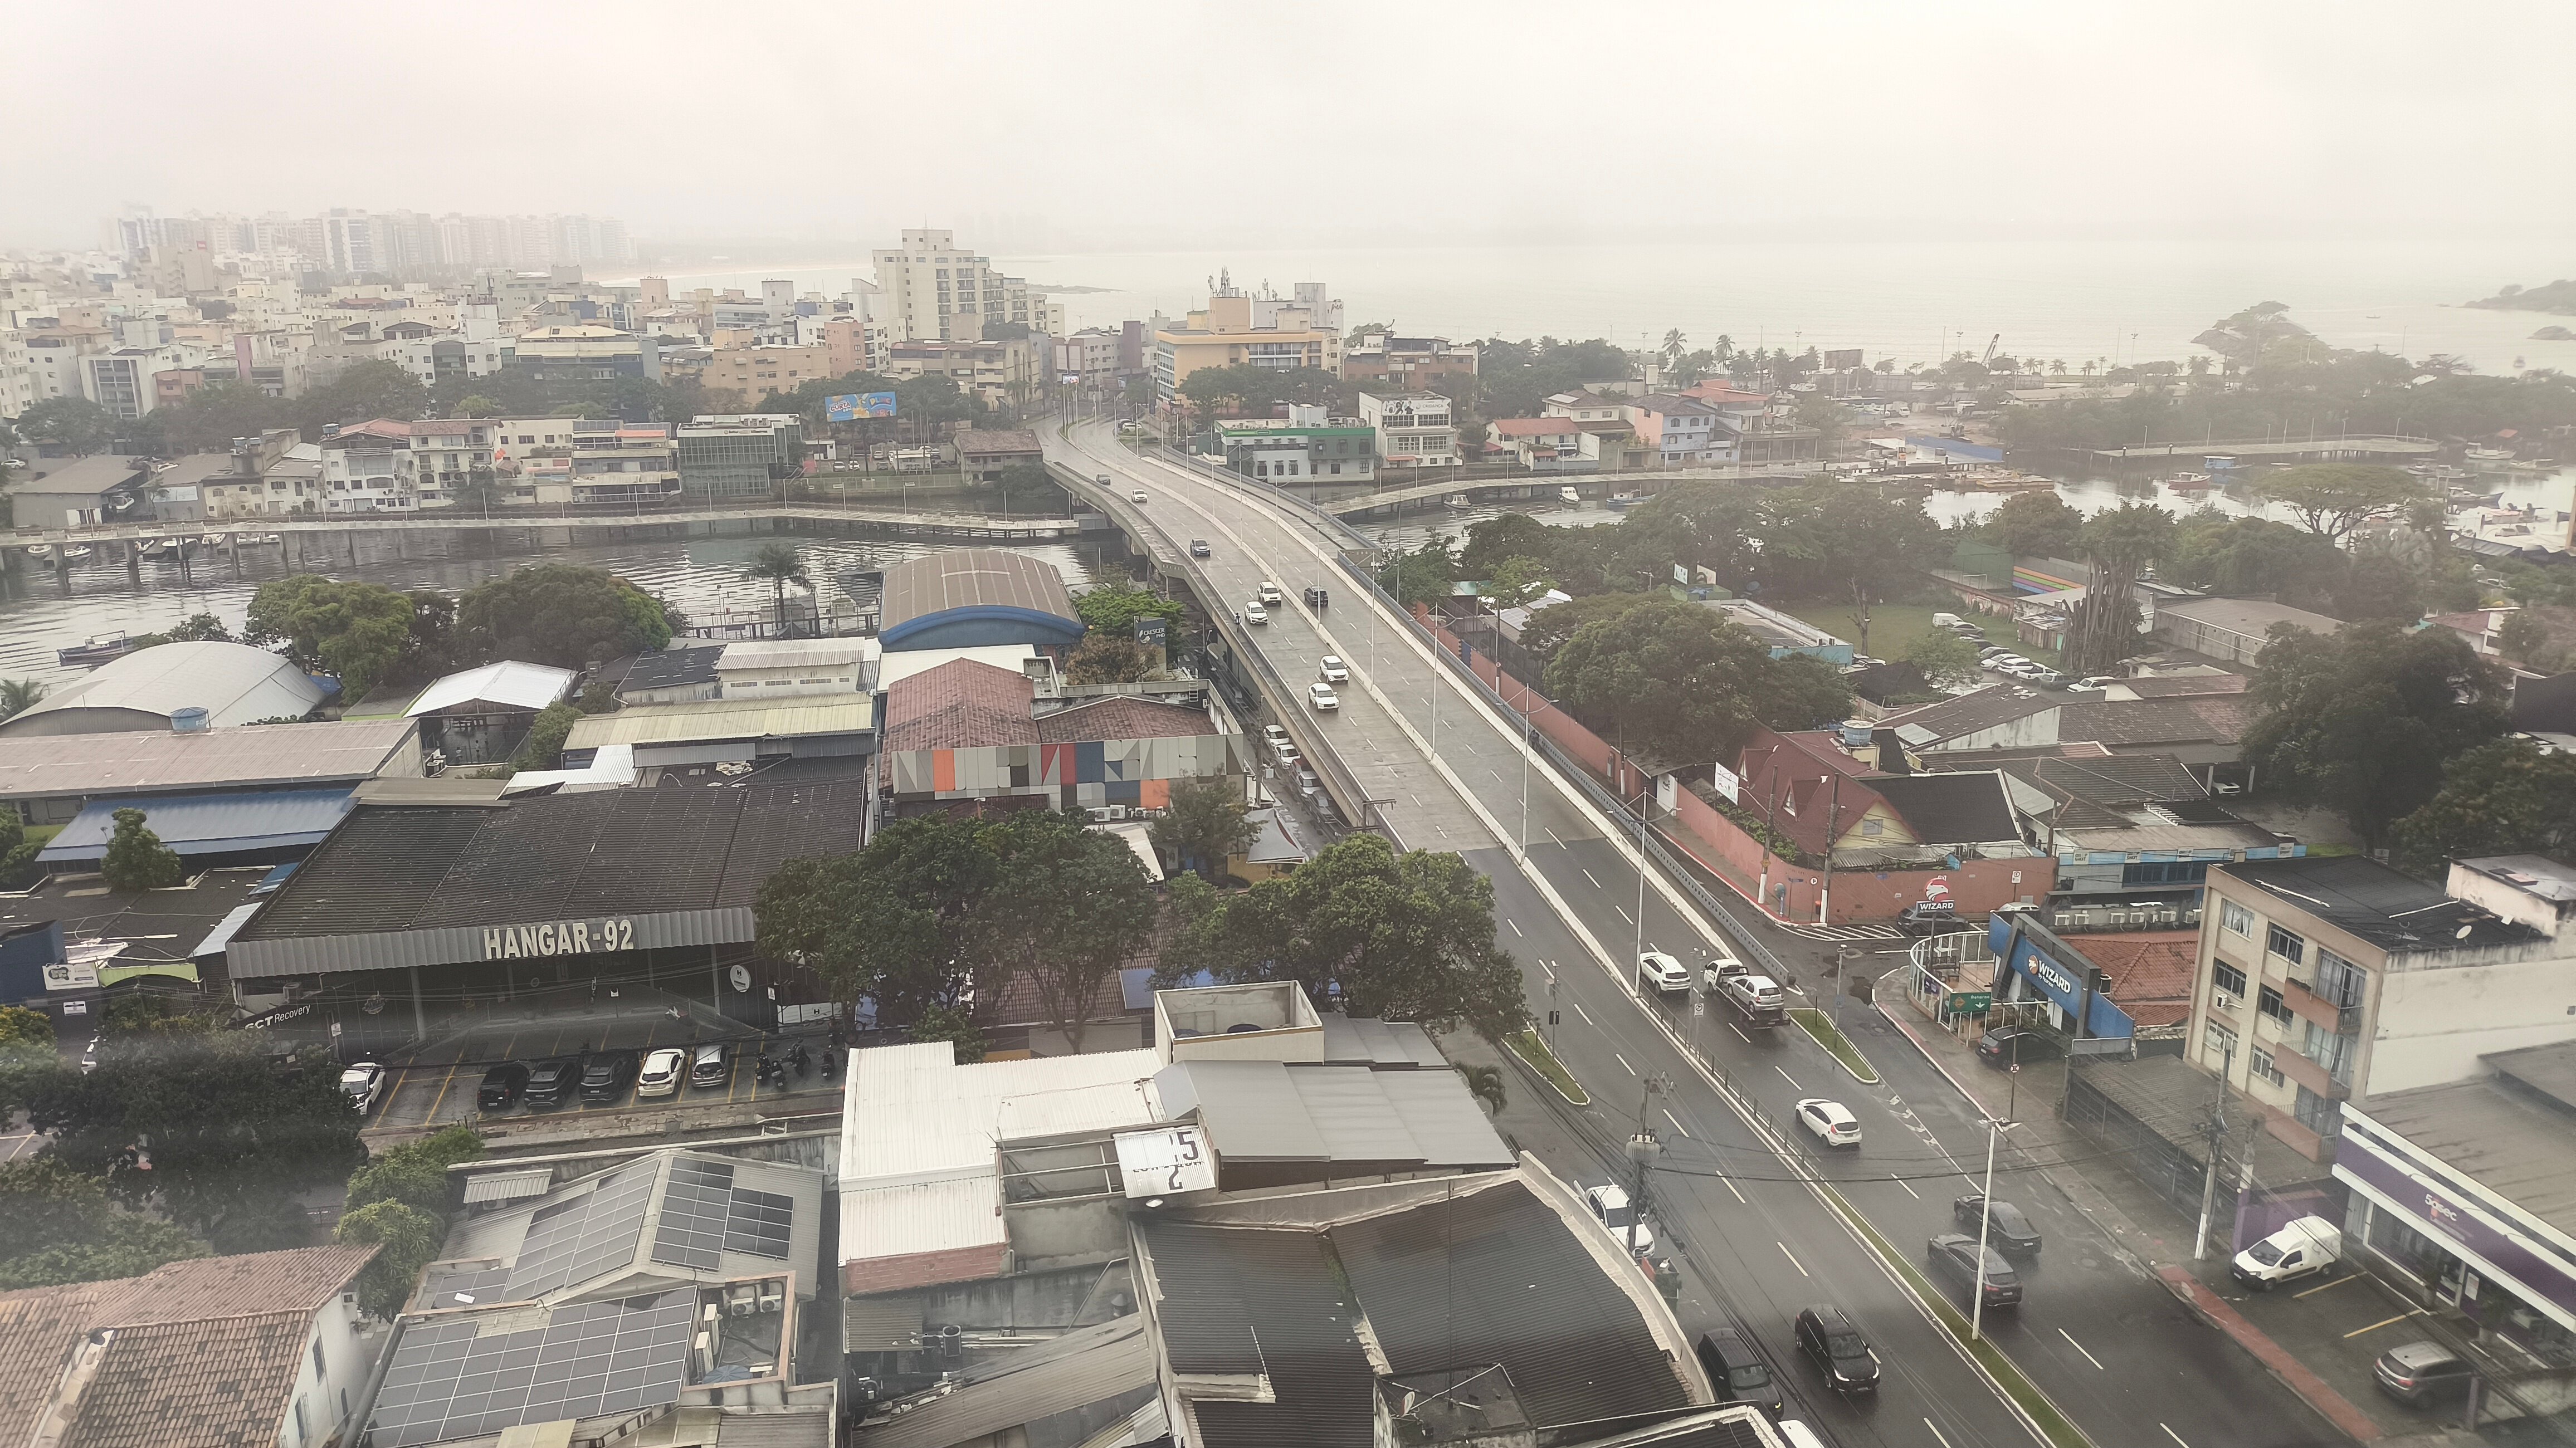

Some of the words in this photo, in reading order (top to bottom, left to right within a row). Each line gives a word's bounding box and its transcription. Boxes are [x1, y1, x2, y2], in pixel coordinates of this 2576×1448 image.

[1143, 628, 1165, 636] CRESCER
[1919, 902, 1954, 911] WIZARD
[2039, 960, 2071, 993] WIZARD
[274, 1004, 311, 1024] Recovery
